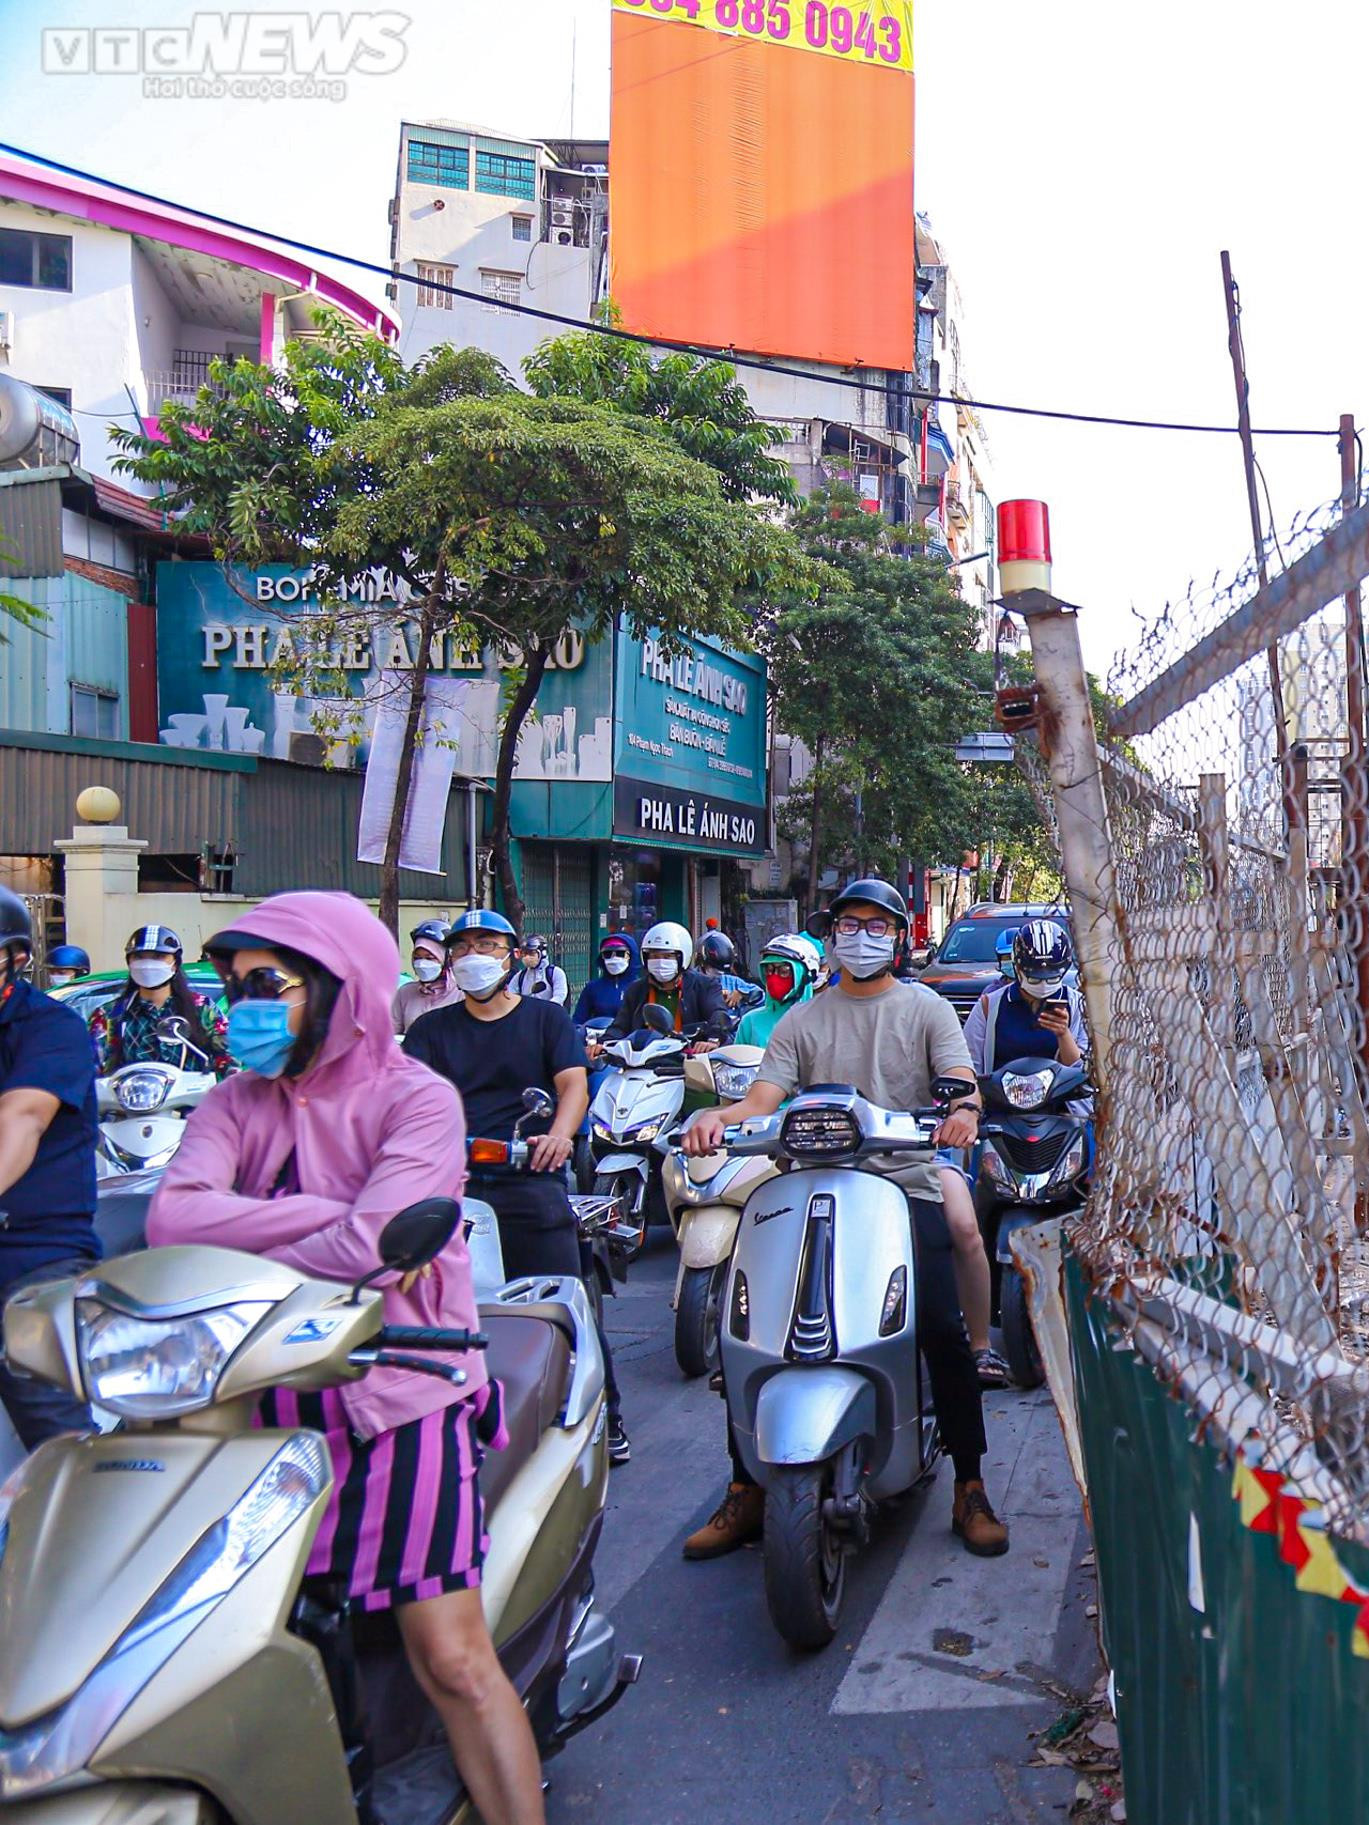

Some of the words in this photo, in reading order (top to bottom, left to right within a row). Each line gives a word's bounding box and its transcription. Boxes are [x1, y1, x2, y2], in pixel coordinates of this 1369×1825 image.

[804, 0, 901, 63] 0943
[641, 798, 673, 832] PHA
[678, 799, 696, 836] LÊ
[700, 802, 728, 840] ÁNH
[731, 816, 755, 845] SAO
[754, 1206, 795, 1226] Vespa
